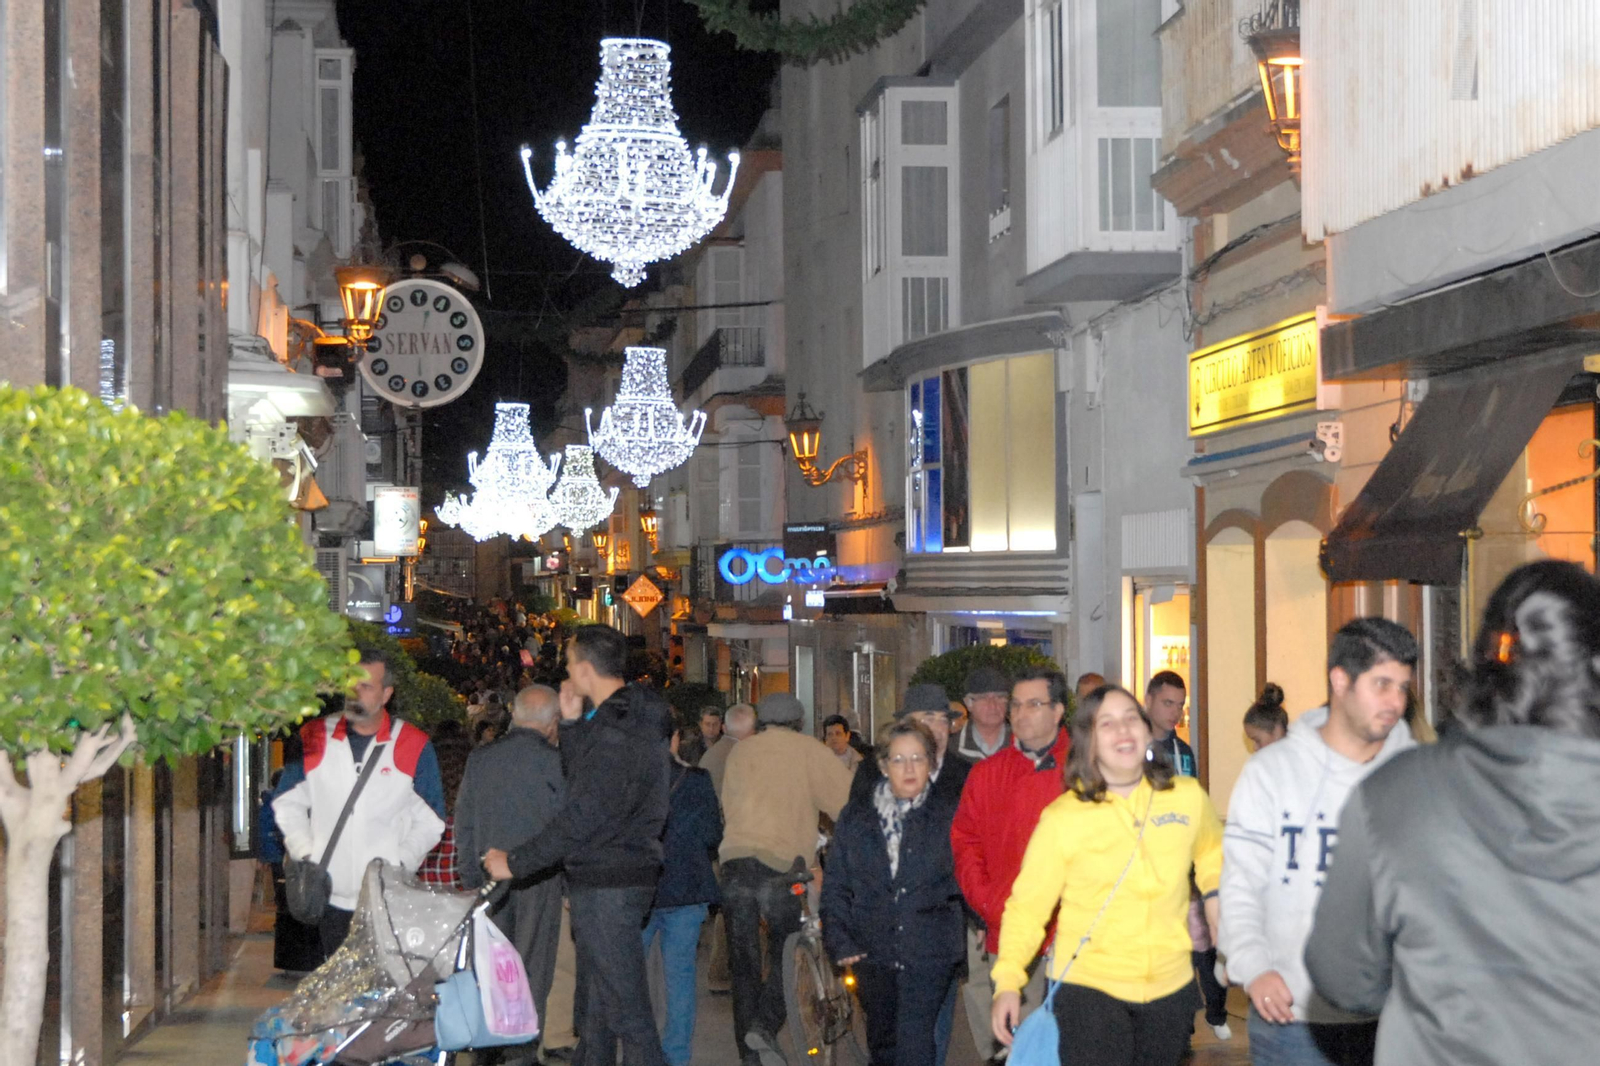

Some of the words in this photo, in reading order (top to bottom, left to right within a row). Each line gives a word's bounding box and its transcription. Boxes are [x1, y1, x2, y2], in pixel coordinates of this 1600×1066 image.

[384, 332, 453, 355] SERVAN
[1241, 348, 1267, 384] ARTES
[1268, 342, 1275, 376] Y
[1276, 332, 1312, 374] OFICIOS
